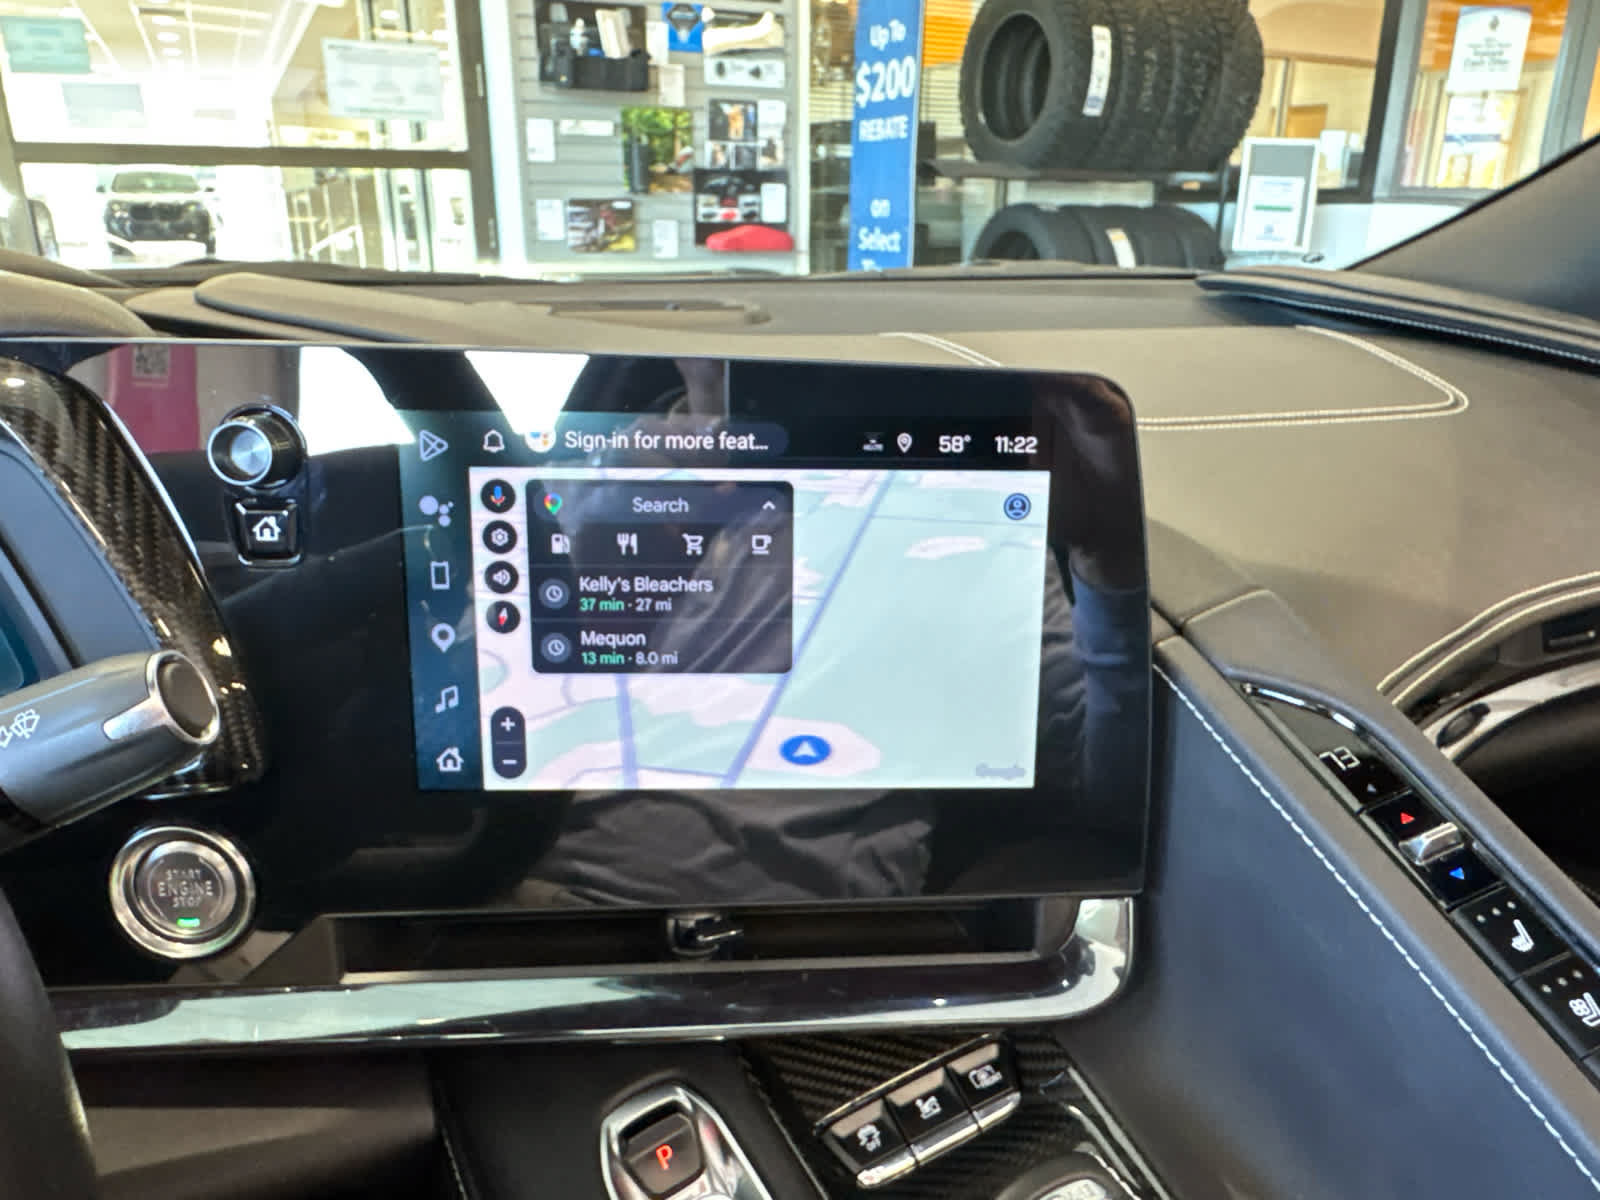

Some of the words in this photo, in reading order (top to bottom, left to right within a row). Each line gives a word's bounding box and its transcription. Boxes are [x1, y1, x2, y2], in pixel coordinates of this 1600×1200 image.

[856, 56, 916, 108] $200
[858, 115, 908, 142] REBATE
[858, 226, 901, 252] Select
[565, 431, 629, 452] Sign-in
[634, 431, 660, 449] for
[665, 434, 714, 450] more
[939, 434, 972, 453] 58°
[994, 436, 1038, 454] 11:22
[632, 496, 689, 513] Search
[580, 576, 630, 595] Kelly's
[634, 576, 714, 593] Bleachers
[580, 598, 596, 611] 37
[600, 598, 625, 611] min
[635, 598, 652, 611] 27
[655, 598, 672, 611] mi
[580, 630, 647, 649] Mequon
[582, 652, 597, 665] 13
[600, 651, 625, 665] min
[635, 651, 659, 665] 8.0
[661, 651, 679, 665] mi
[158, 880, 214, 897] ENGINE
[173, 896, 202, 908] STOP
[656, 1144, 673, 1170] P
